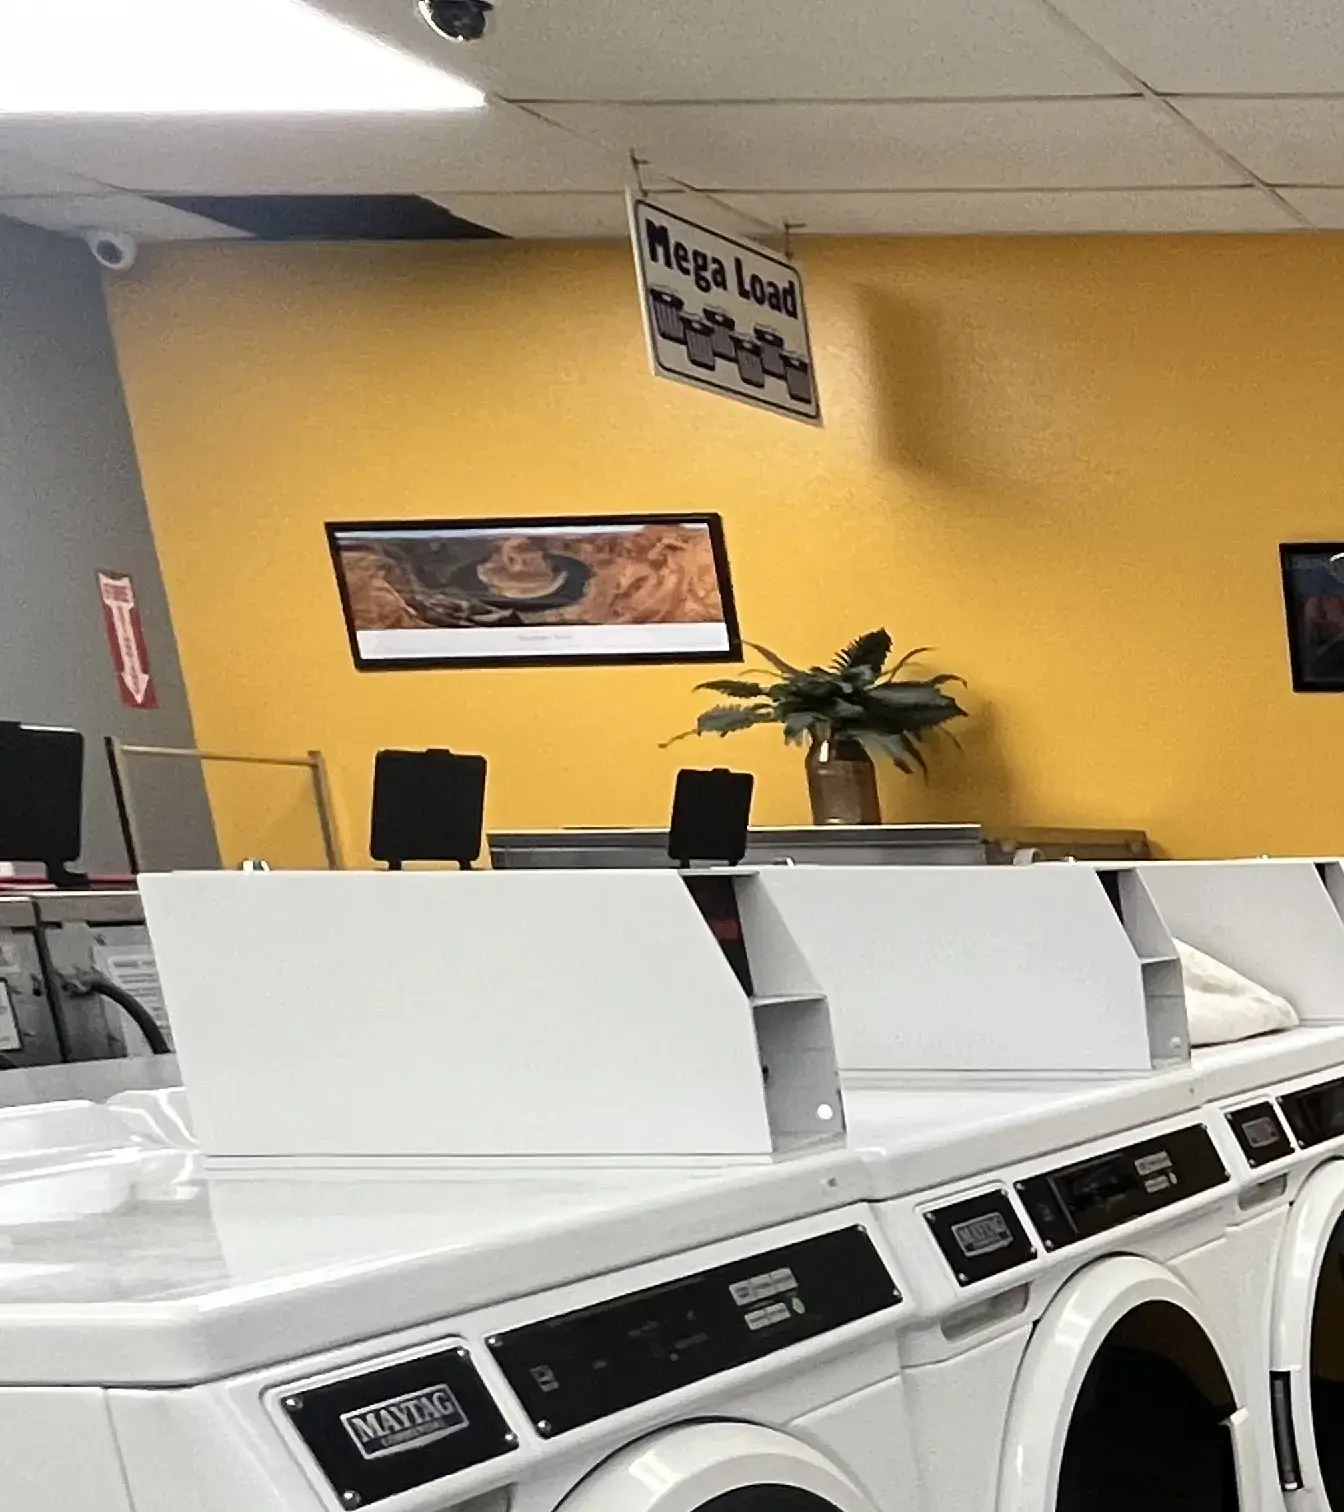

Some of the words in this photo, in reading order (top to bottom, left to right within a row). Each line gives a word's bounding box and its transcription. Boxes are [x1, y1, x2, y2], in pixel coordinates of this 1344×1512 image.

[646, 219, 728, 293] Mega
[735, 257, 799, 319] Load
[352, 1392, 454, 1442] MAYTAG
